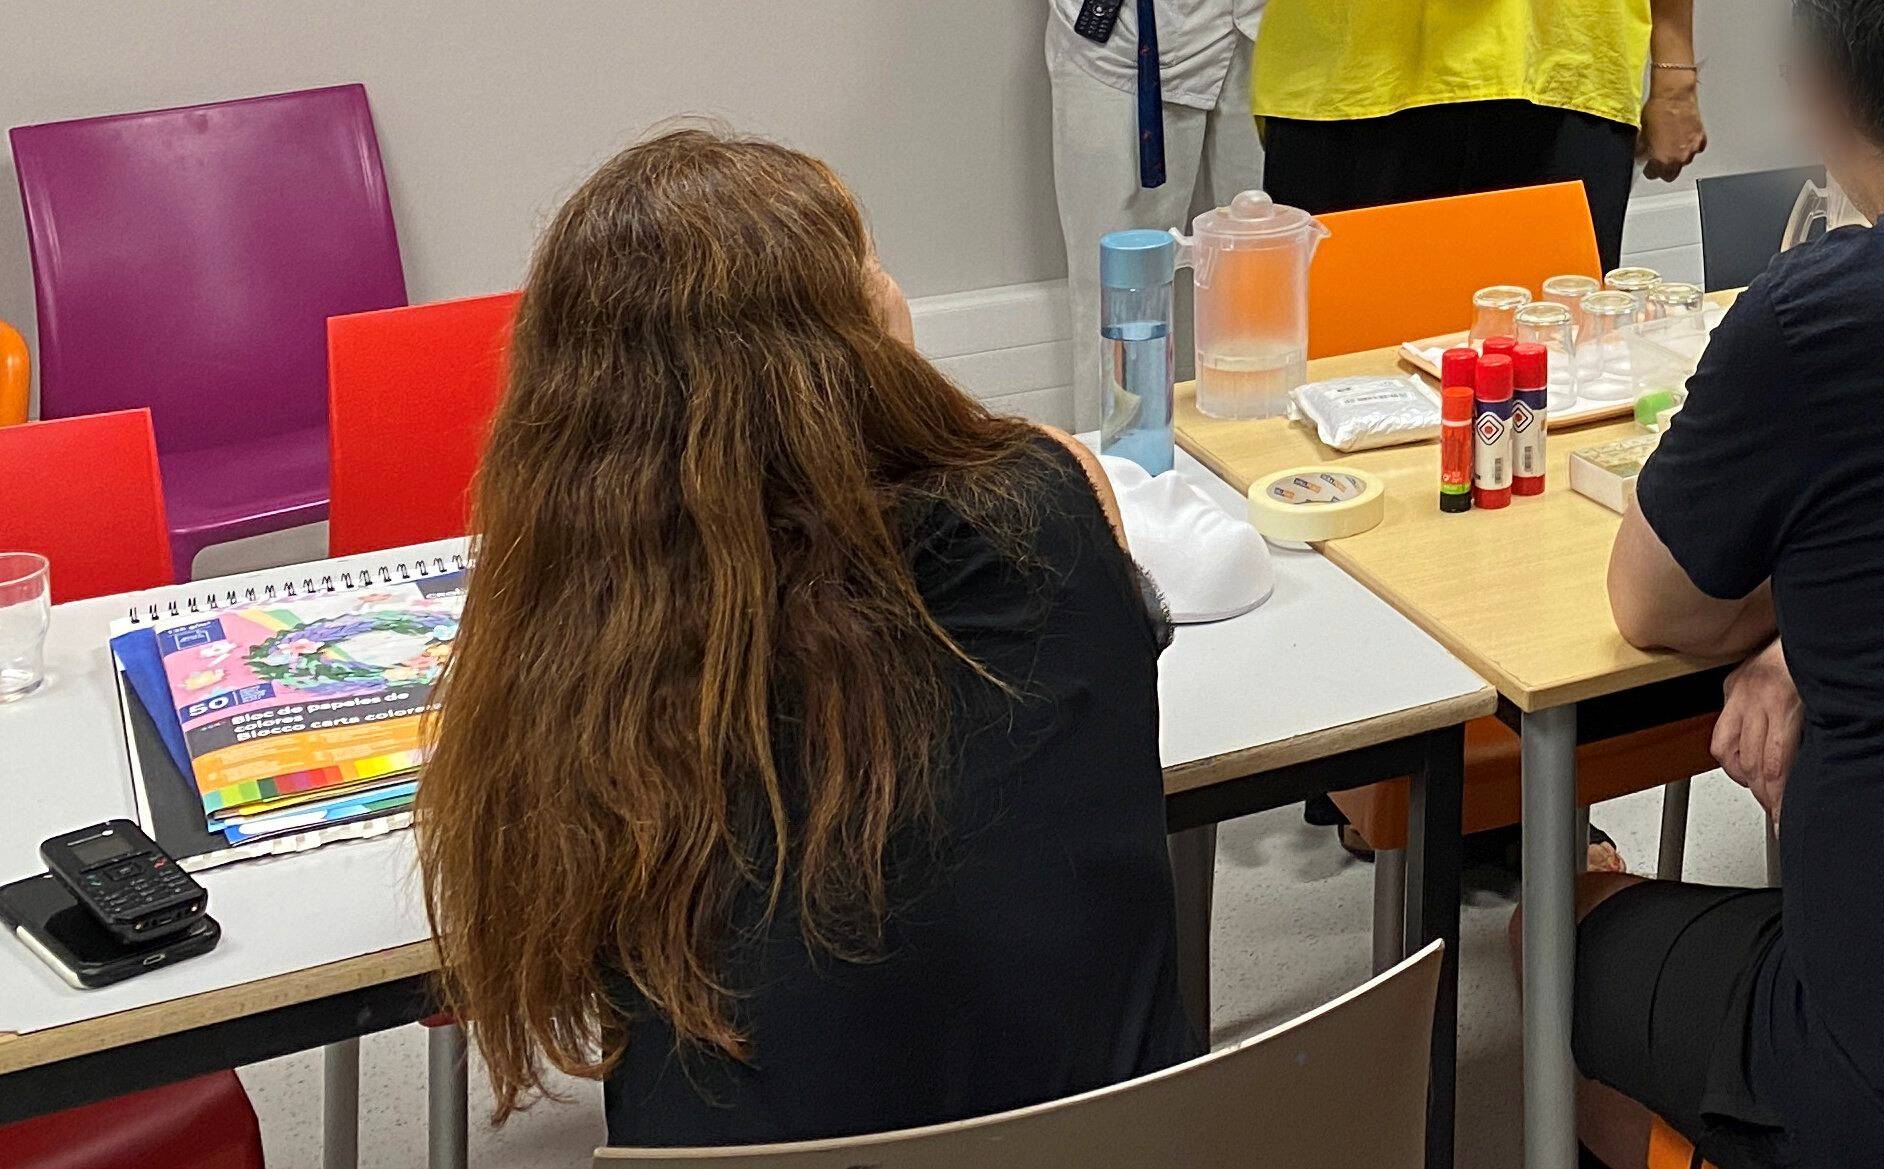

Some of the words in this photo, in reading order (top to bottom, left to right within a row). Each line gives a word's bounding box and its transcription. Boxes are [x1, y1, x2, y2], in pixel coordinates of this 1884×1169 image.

[188, 696, 230, 718] 50
[231, 710, 275, 726] Bloc
[276, 706, 304, 717] de
[306, 697, 382, 714] papeles
[384, 692, 410, 702] de
[233, 715, 304, 733] colores
[236, 724, 306, 742] Blocco
[310, 717, 360, 729] carta
